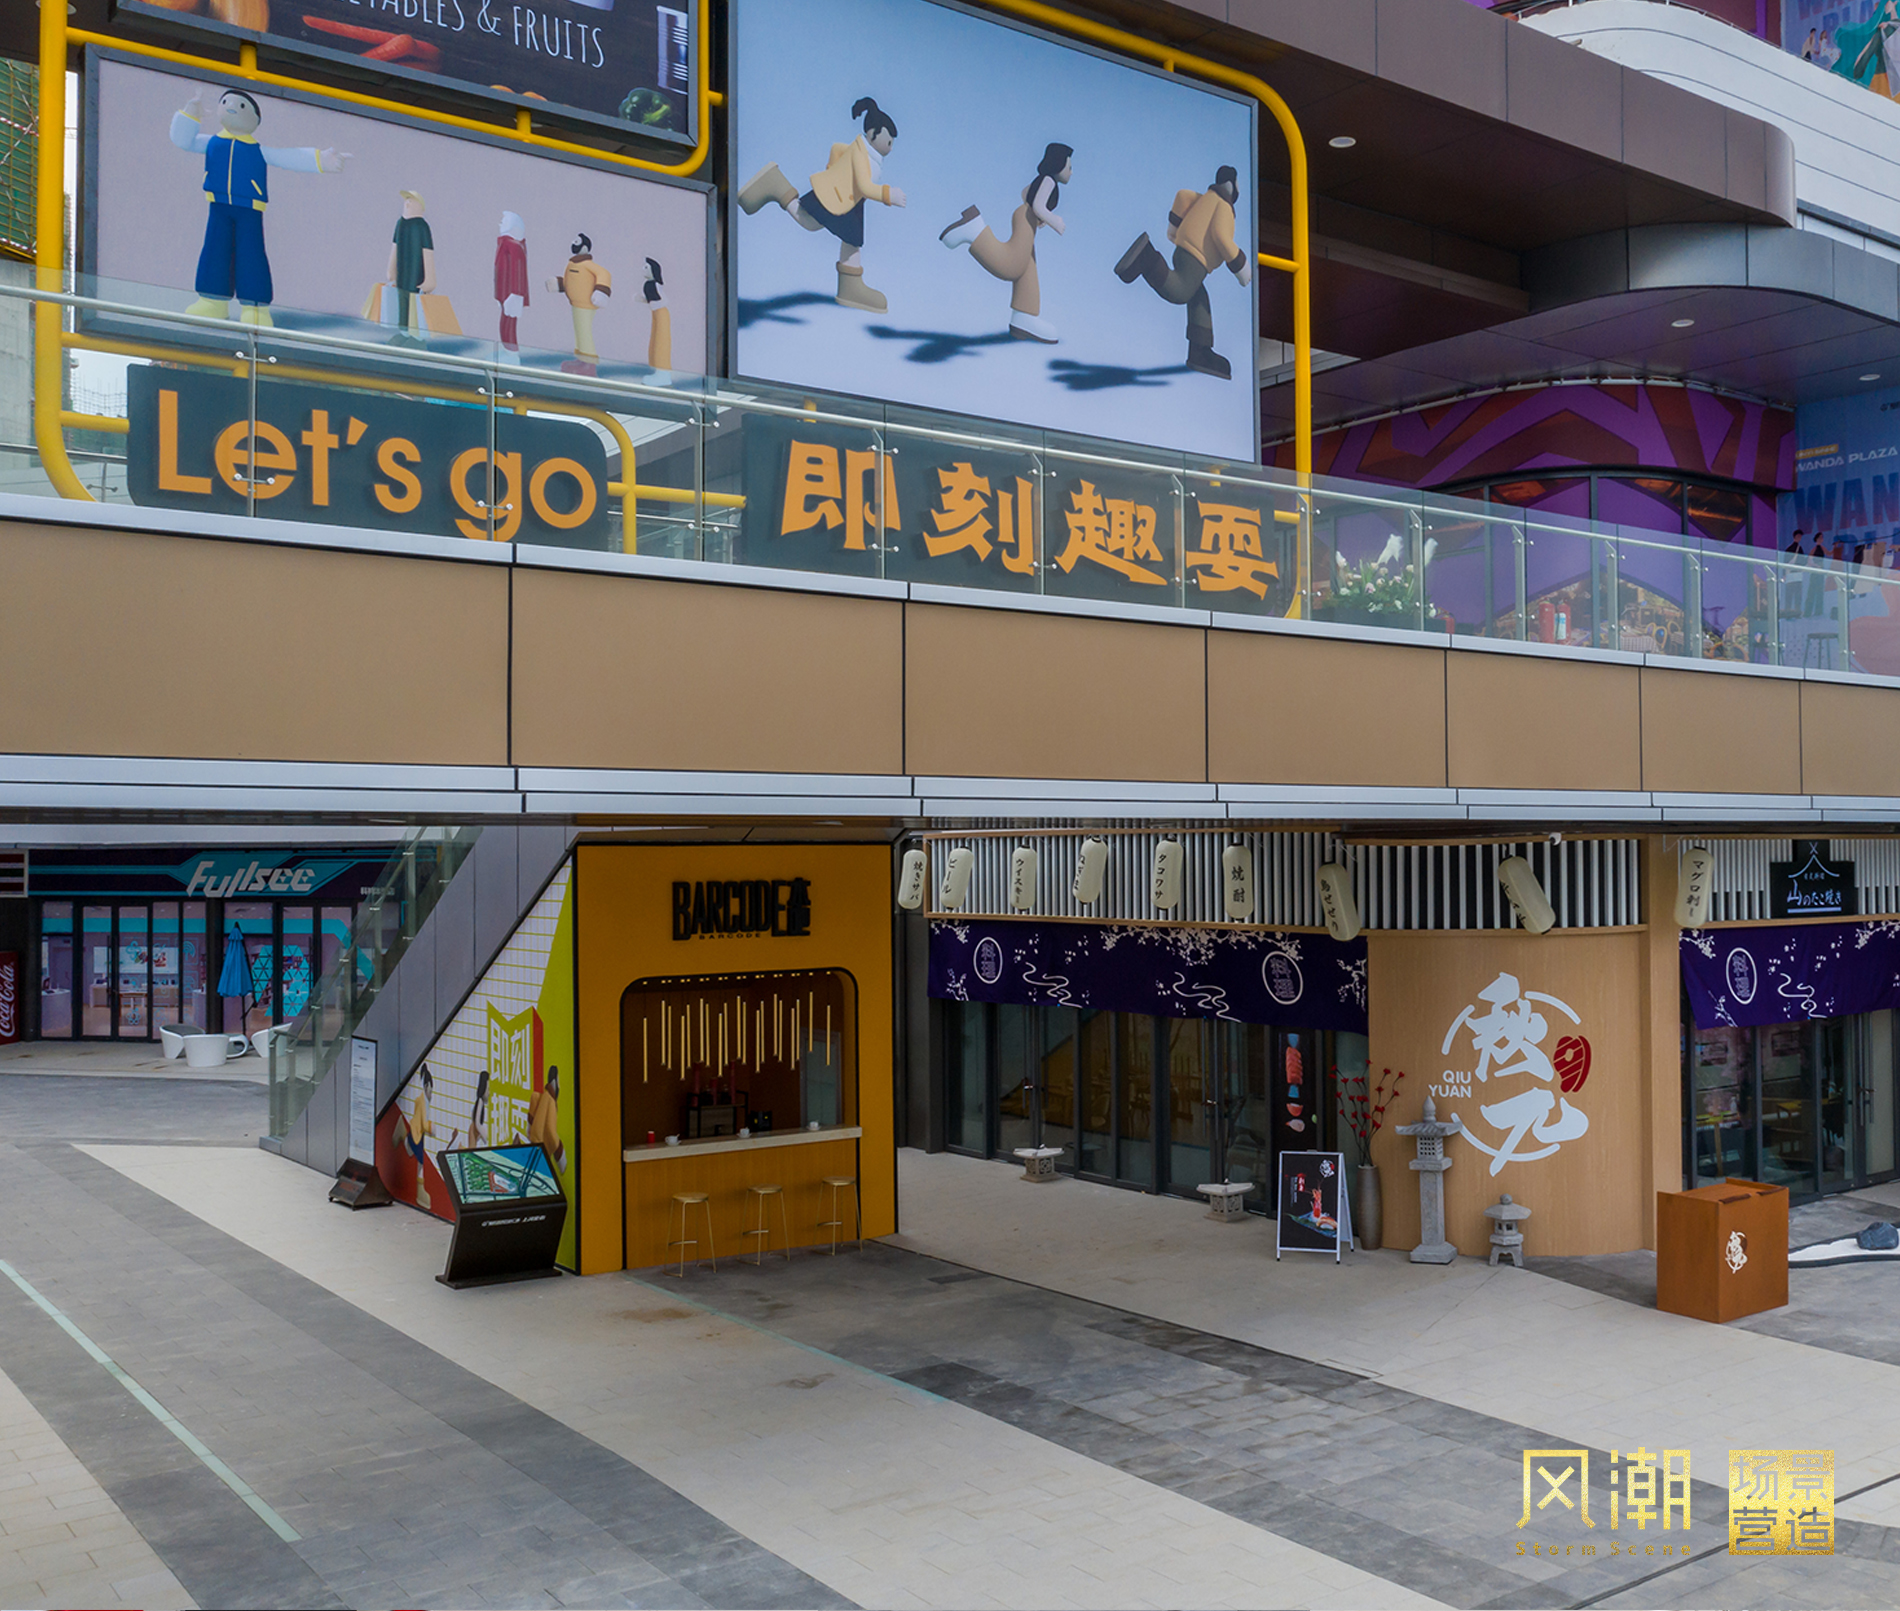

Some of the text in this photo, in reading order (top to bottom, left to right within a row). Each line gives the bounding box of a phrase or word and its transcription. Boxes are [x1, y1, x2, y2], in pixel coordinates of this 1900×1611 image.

[513, 6, 605, 68] FRUITS
[158, 388, 597, 543] Let's go
[1848, 446, 1899, 463] PLAZA
[780, 439, 1279, 600] 即刻趣耍
[1231, 865, 1245, 904] 焼酎
[672, 880, 787, 941] BARCODE
[699, 932, 762, 940] BARCODE
[489, 1016, 531, 1091] 即刻
[1442, 1069, 1472, 1084] QIU
[1428, 1084, 1472, 1099] YUAN
